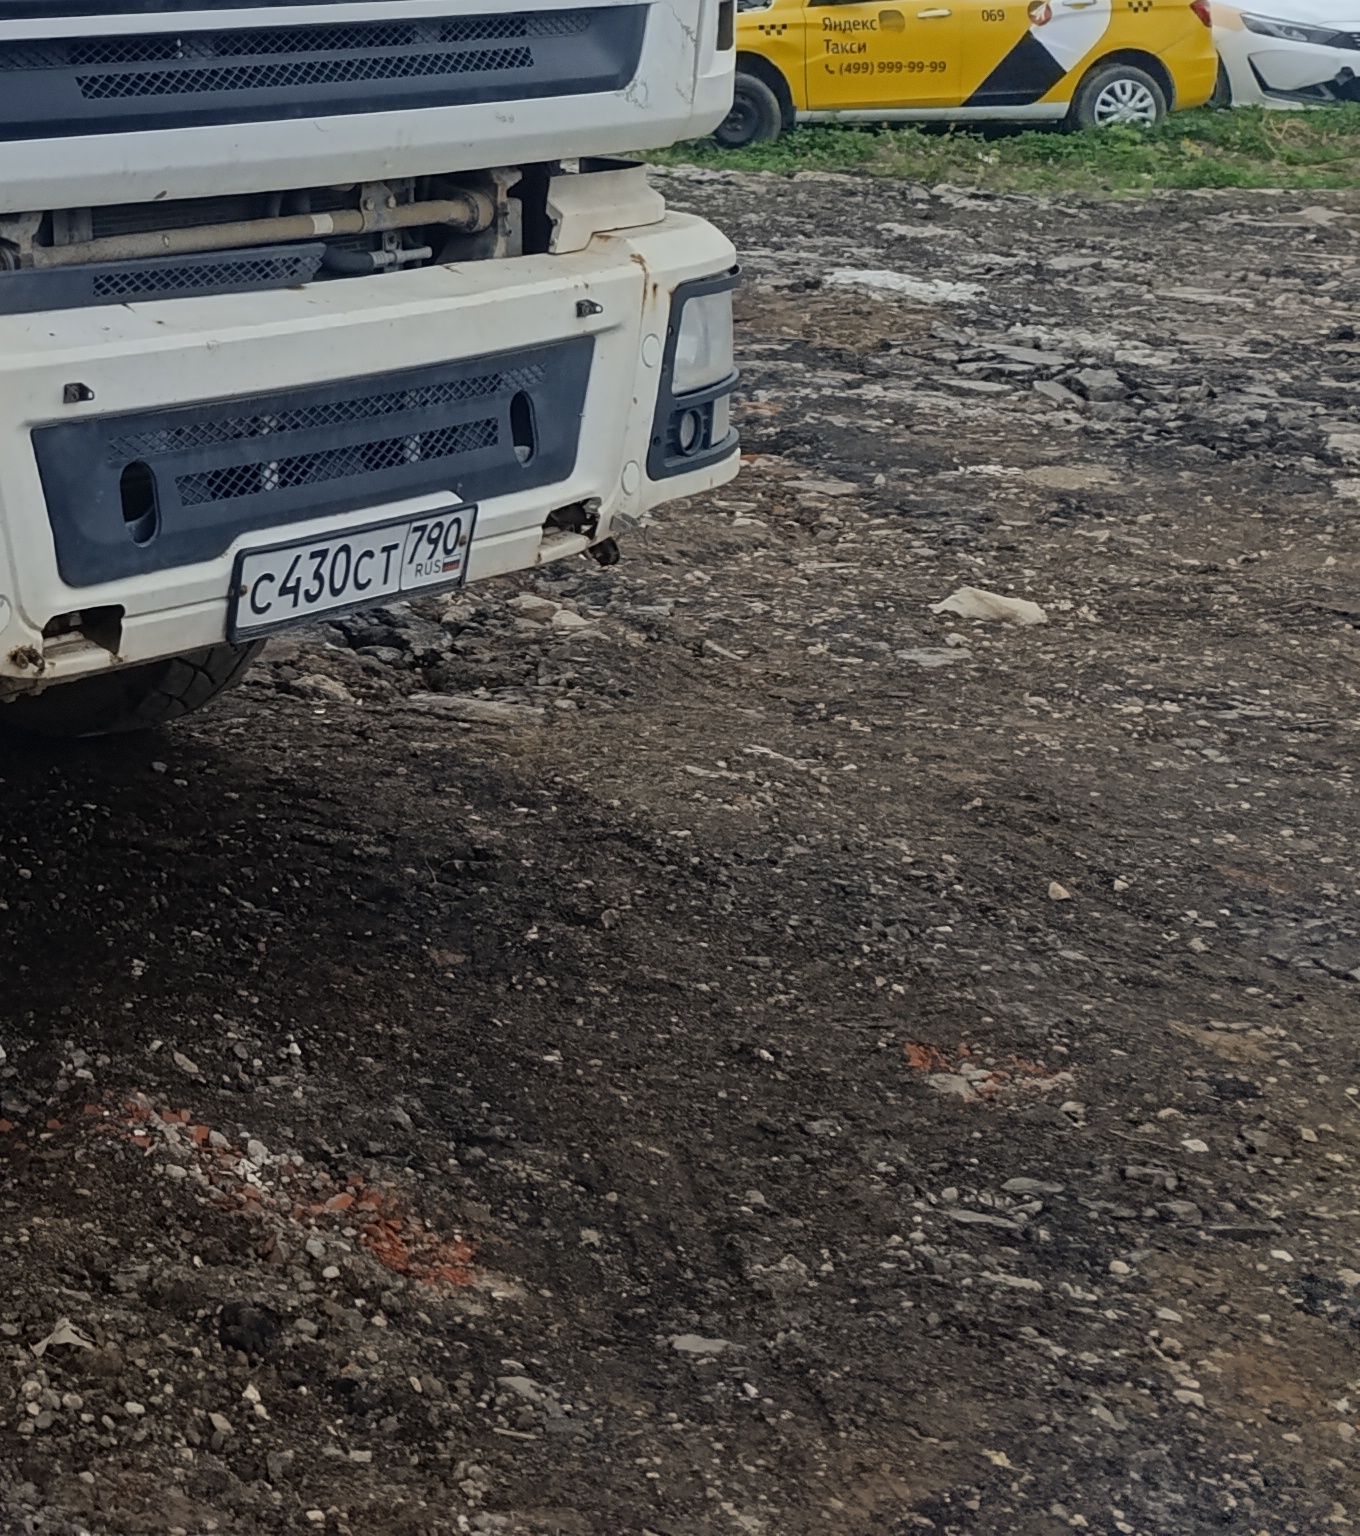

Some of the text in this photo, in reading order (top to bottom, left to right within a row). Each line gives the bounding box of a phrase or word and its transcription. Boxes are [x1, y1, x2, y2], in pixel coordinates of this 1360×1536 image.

[981, 9, 1005, 22] 069
[822, 17, 878, 33] Яндекс
[823, 39, 867, 54] Такси
[839, 61, 947, 75] (499) 999-99-99
[414, 562, 442, 578] RUS
